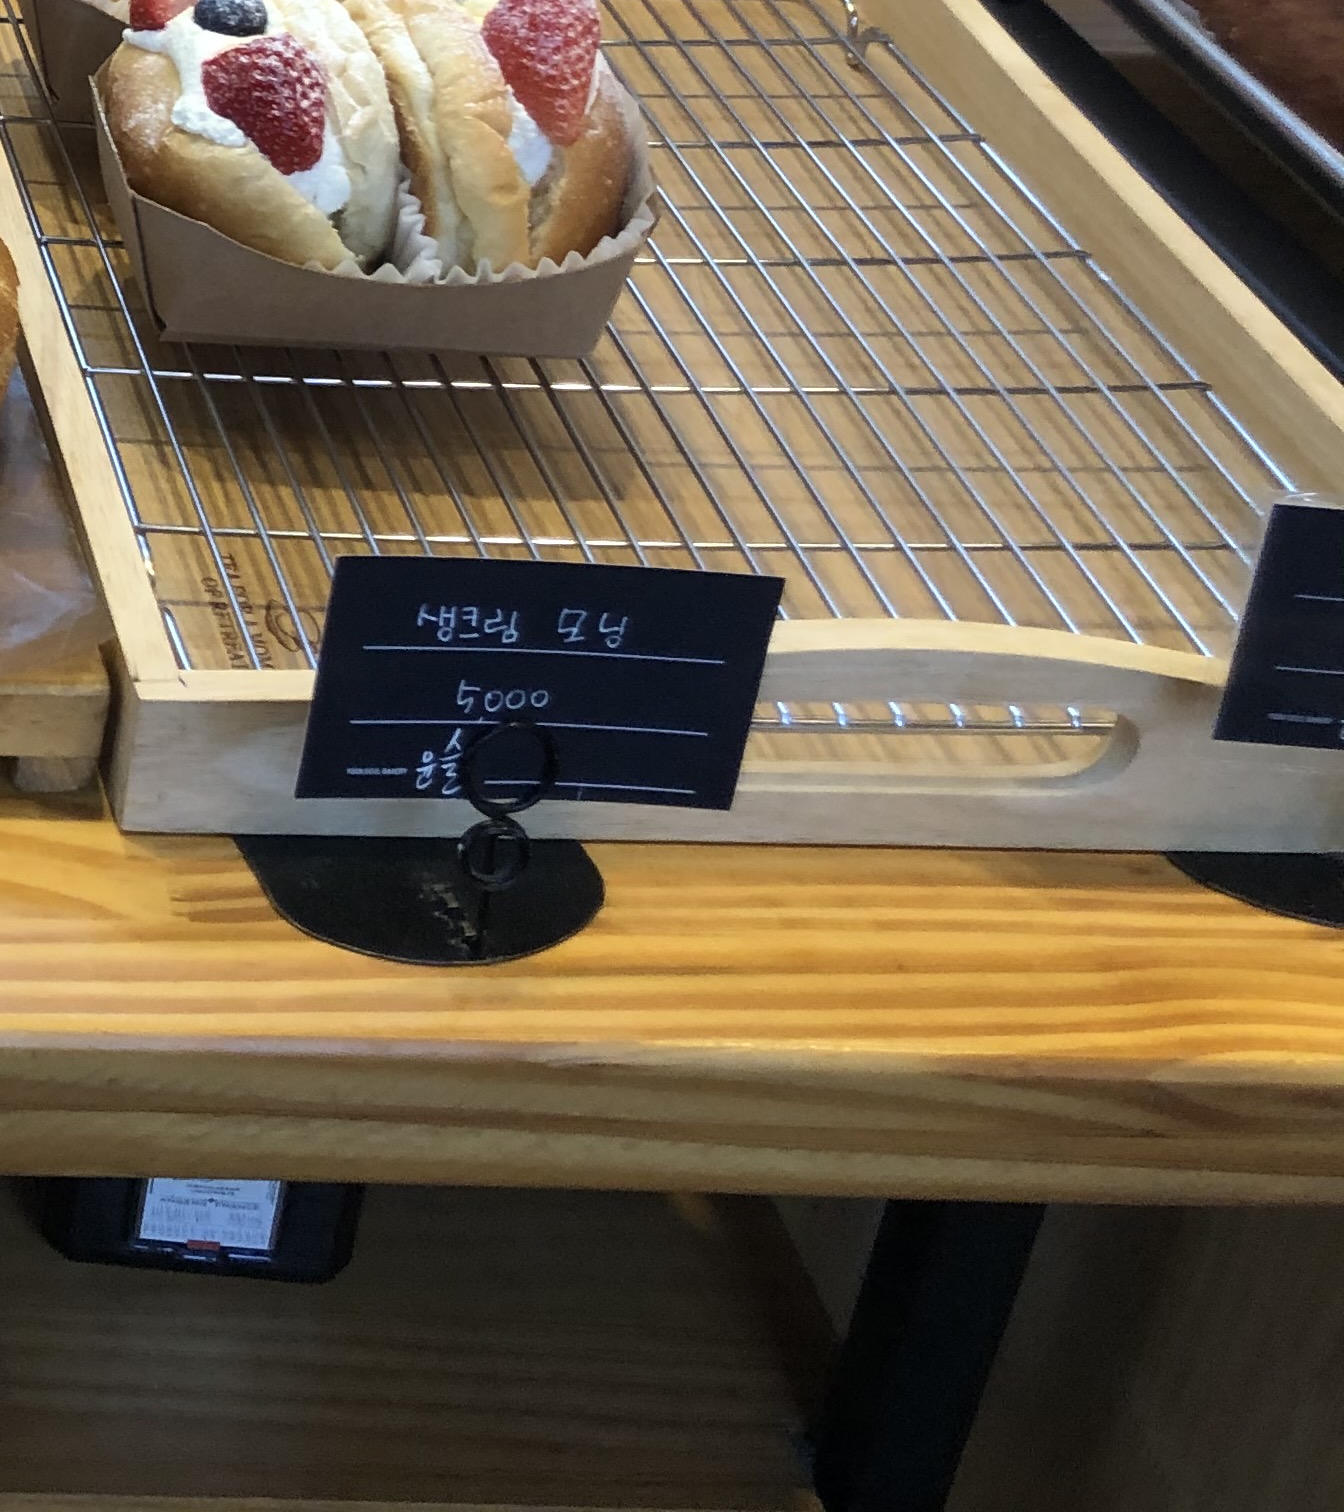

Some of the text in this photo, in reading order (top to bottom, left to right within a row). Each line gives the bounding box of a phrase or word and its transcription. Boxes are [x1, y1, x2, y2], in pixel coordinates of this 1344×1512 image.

[416, 602, 629, 649] 생크림 모닝
[456, 678, 552, 713] 5000
